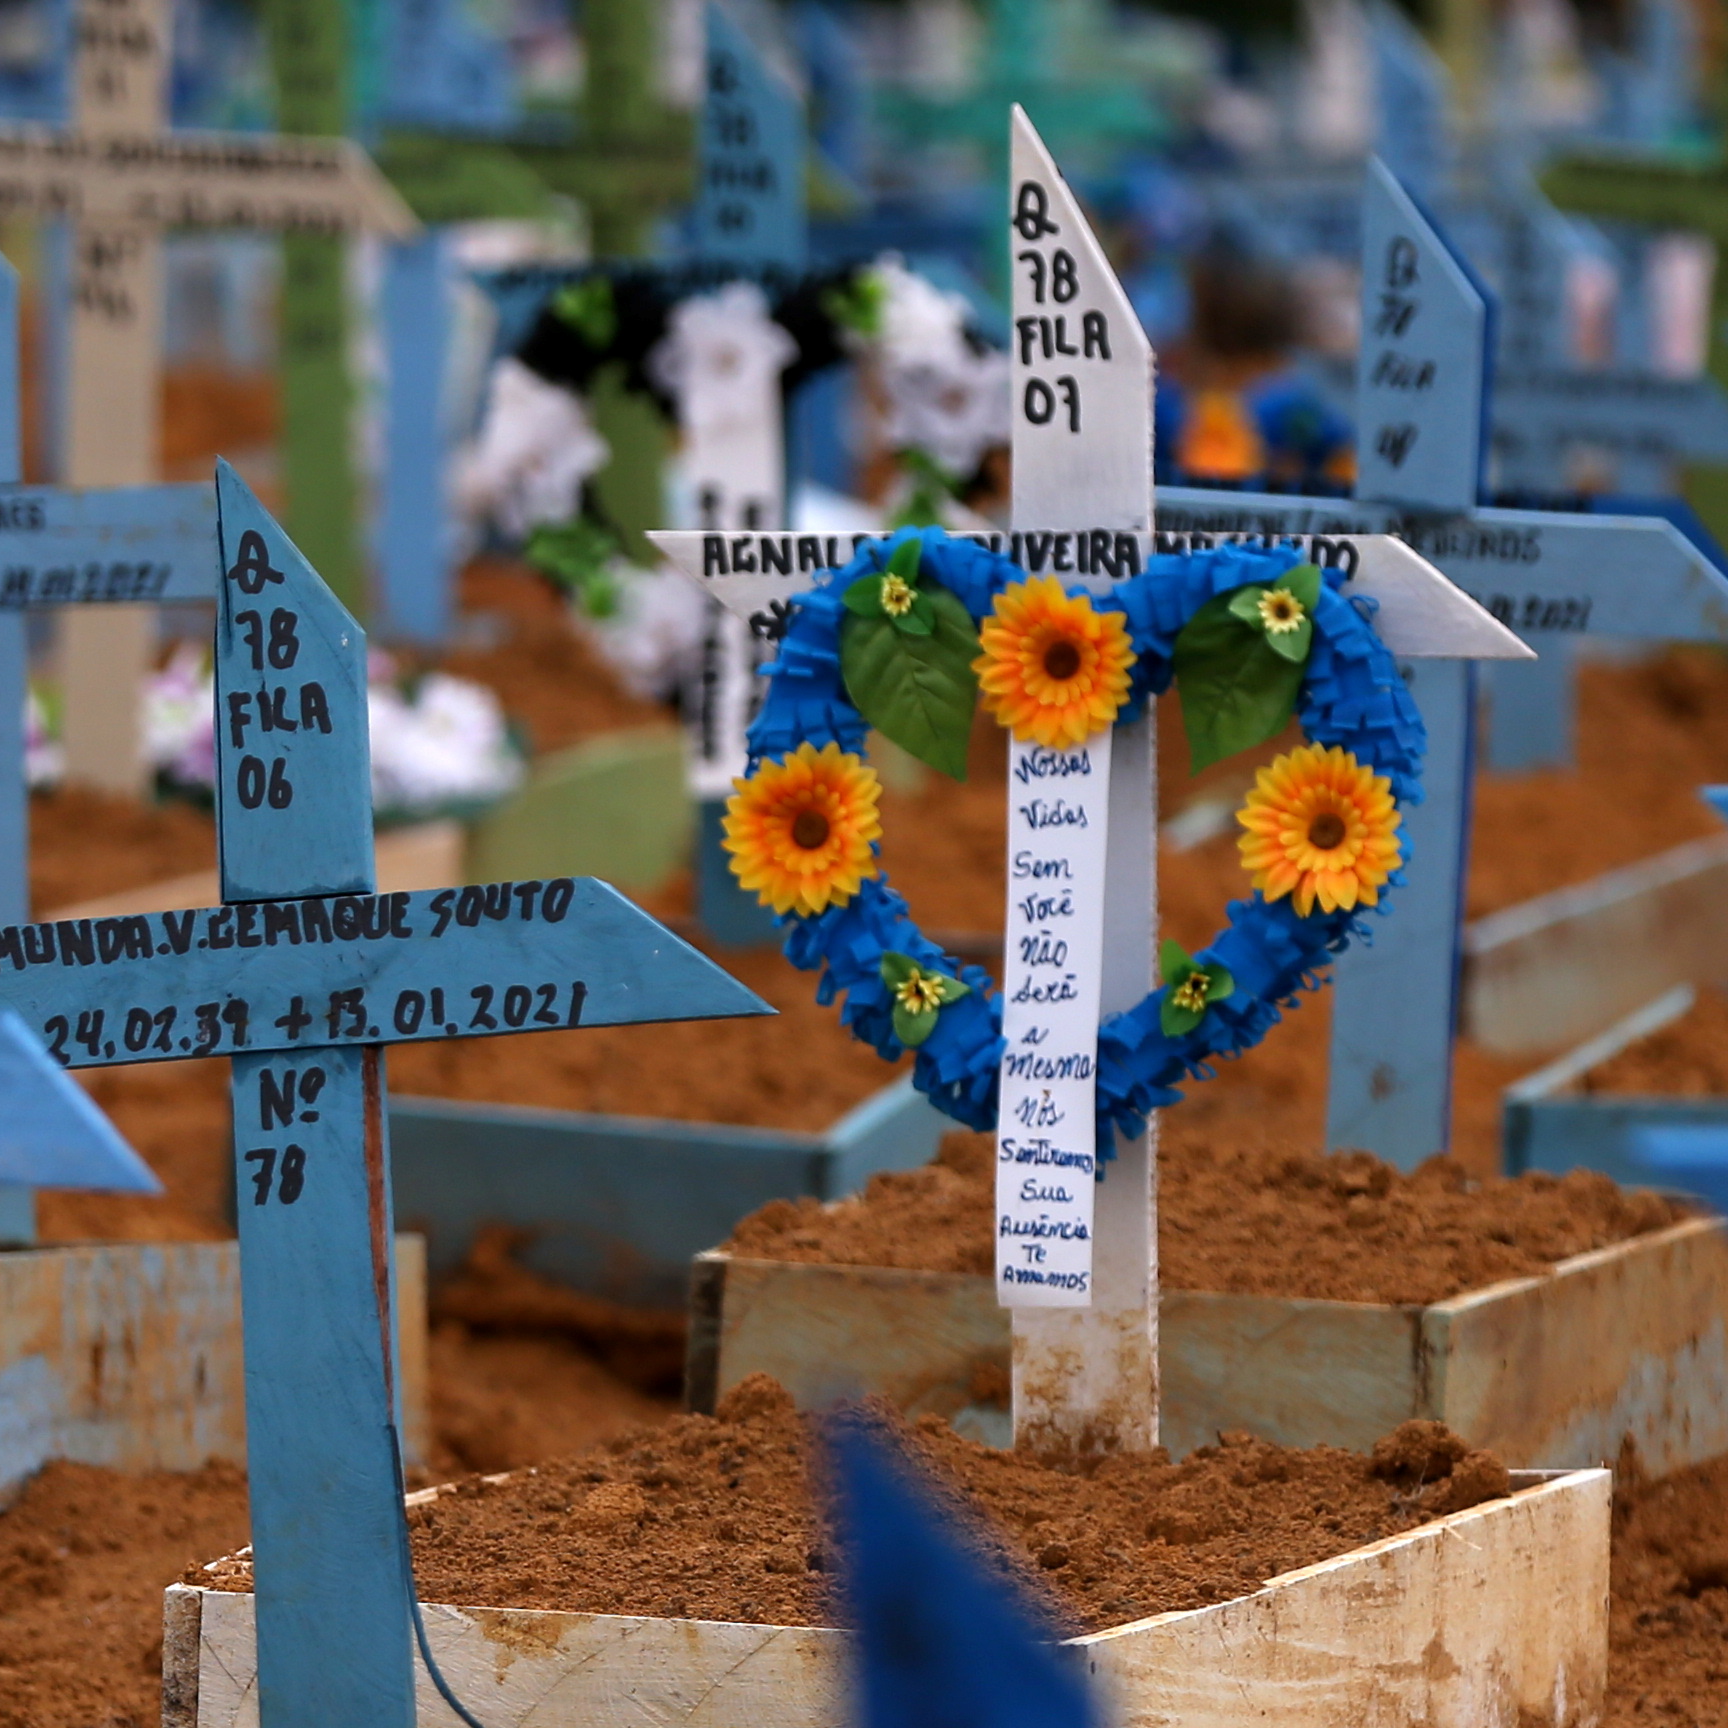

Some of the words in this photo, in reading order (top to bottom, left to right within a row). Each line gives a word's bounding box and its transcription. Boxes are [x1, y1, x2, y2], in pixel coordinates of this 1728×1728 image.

[1012, 179, 1060, 241] Q
[1018, 246, 1080, 303] 78
[1015, 308, 1113, 367] FILA
[1023, 372, 1082, 434] 07
[227, 529, 285, 595] Q
[234, 606, 300, 670] 78
[226, 681, 333, 750] FILA
[236, 754, 294, 810] 06
[428, 877, 577, 939] SOUTO
[244, 1143, 307, 1206] 78
